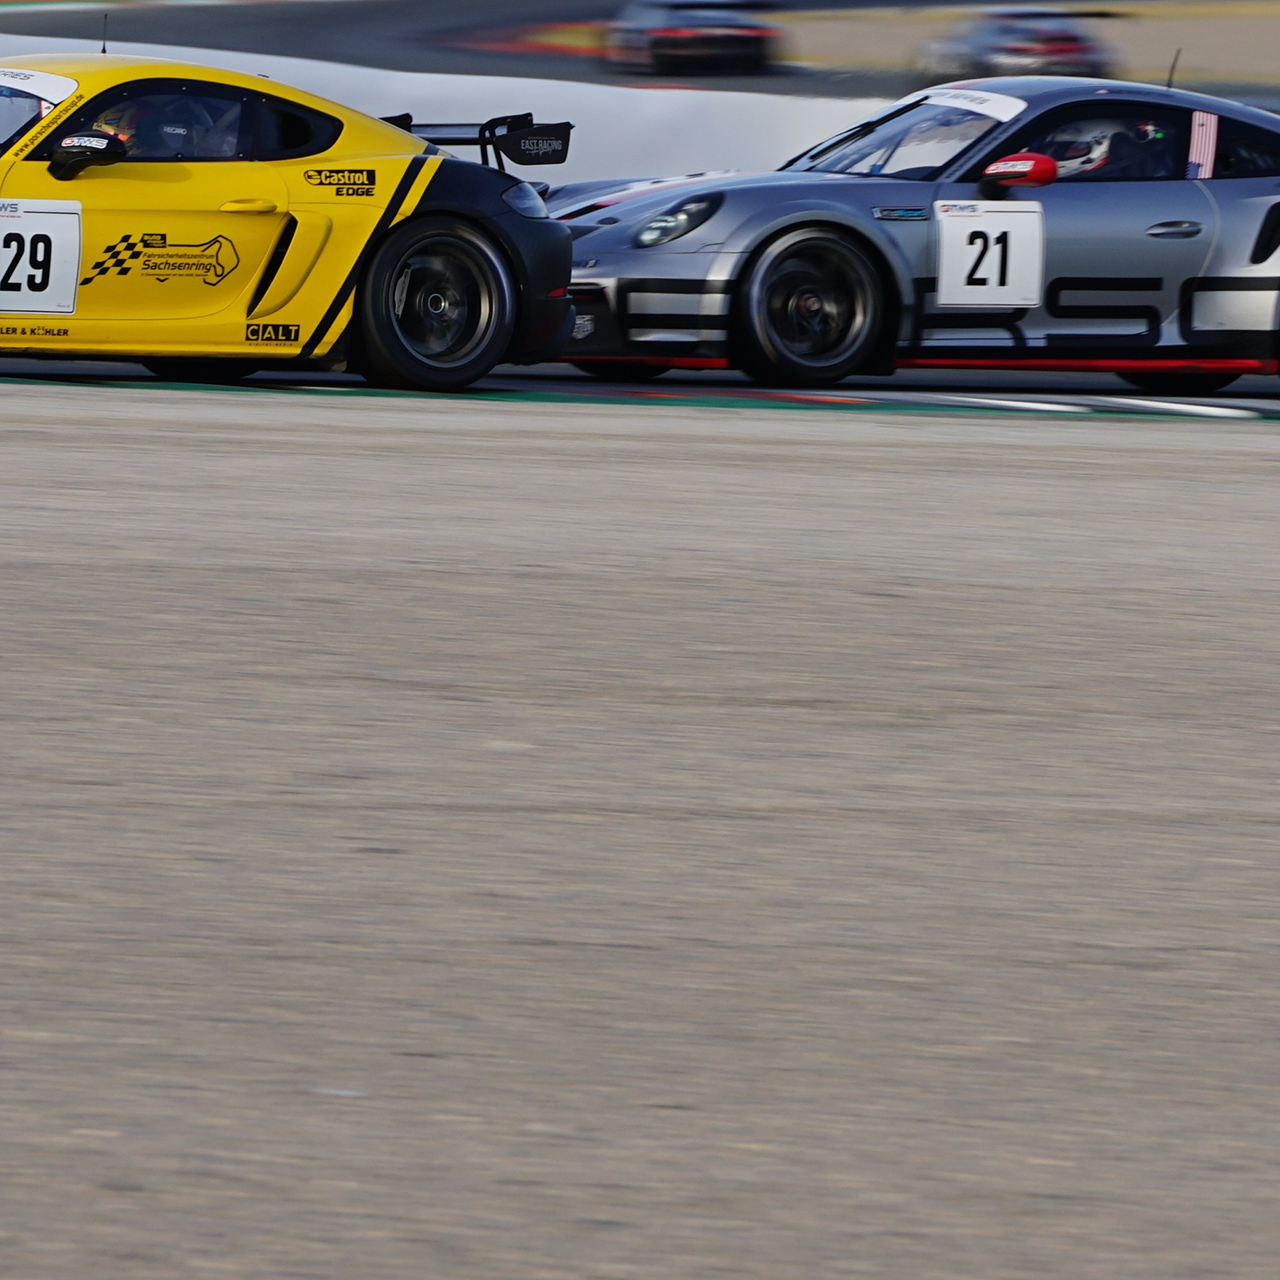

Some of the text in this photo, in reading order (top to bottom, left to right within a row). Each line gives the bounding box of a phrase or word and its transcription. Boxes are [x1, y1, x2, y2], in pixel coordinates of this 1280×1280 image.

[62, 137, 108, 148] GTWS
[320, 170, 369, 184] Castrol
[335, 187, 375, 196] EDGE
[0, 232, 52, 292] 29
[142, 252, 215, 260] Fahrsicherheitszentrum
[965, 230, 1010, 287] 21
[141, 260, 213, 273] Sachsenring
[20, 327, 27, 335] &
[247, 325, 299, 339] CALT
